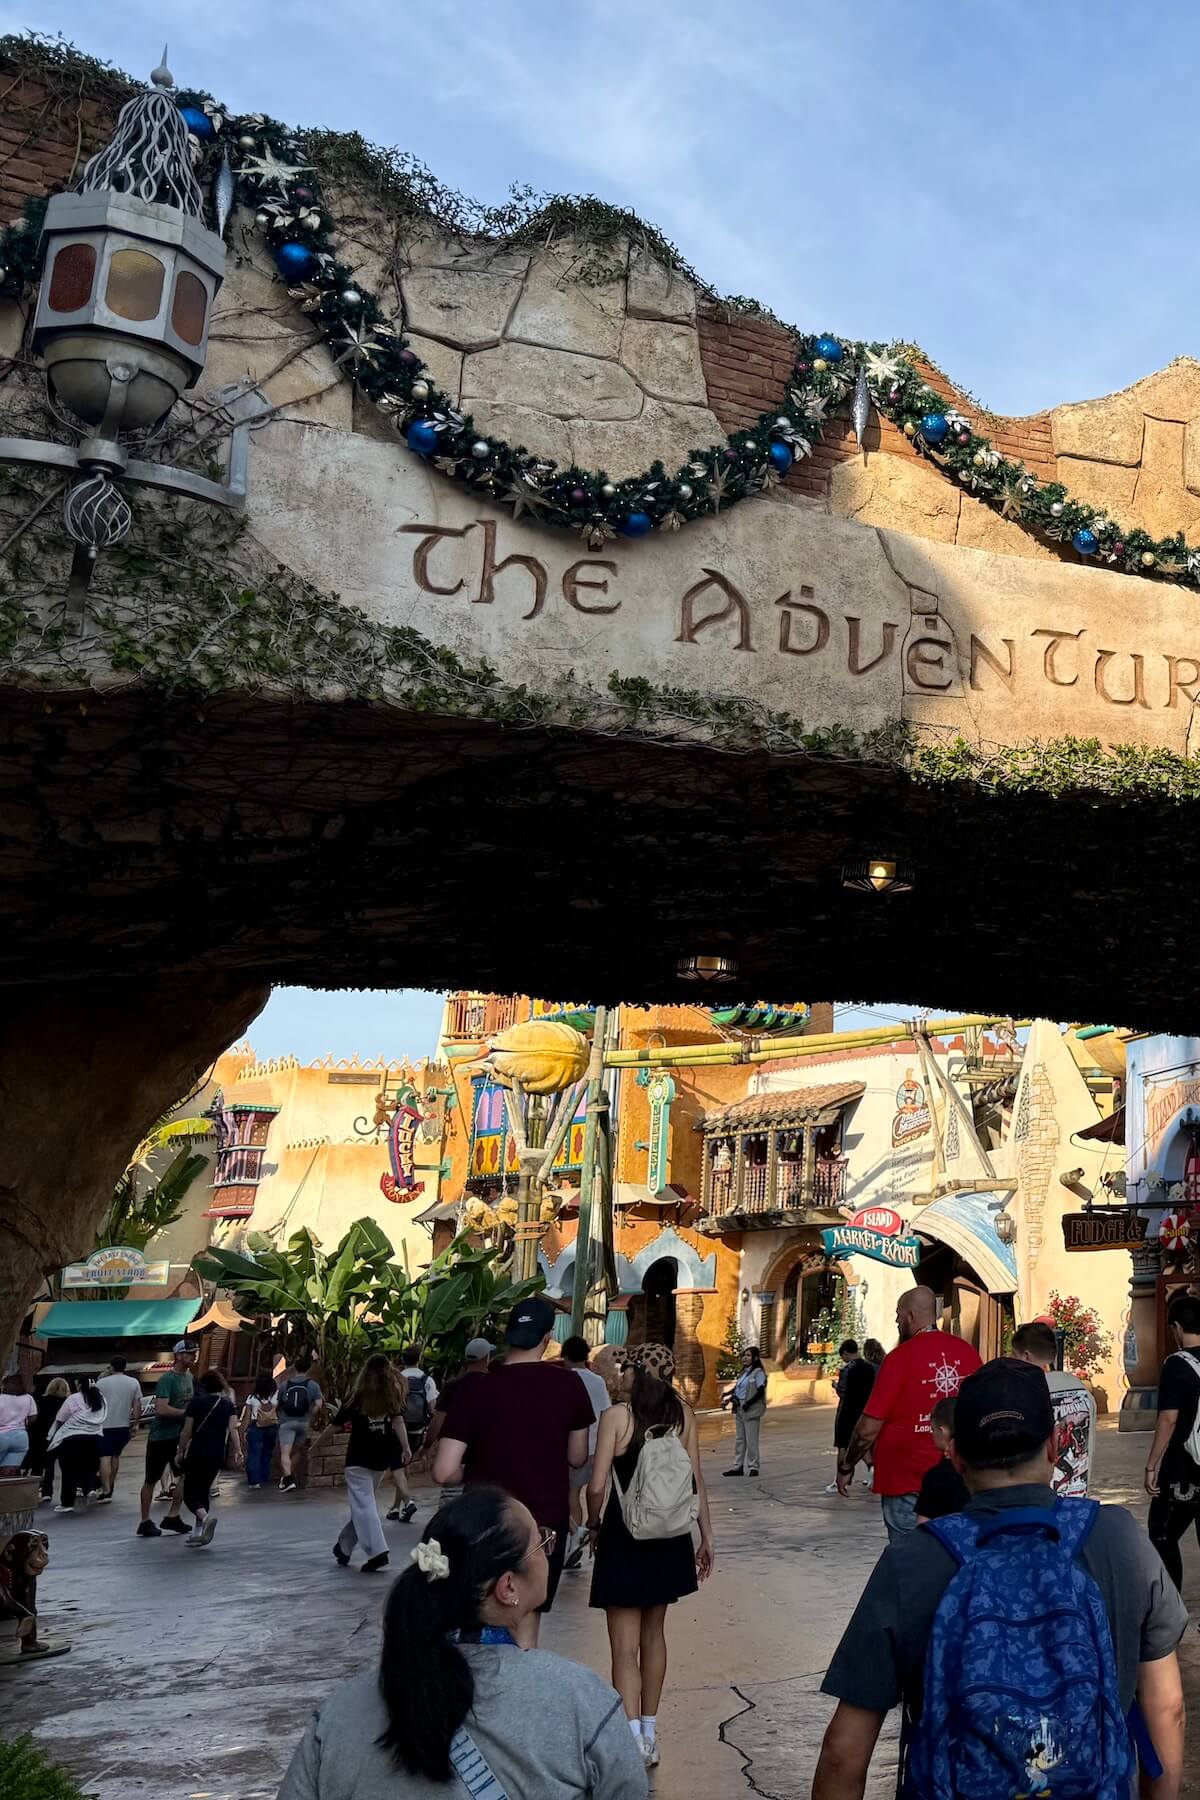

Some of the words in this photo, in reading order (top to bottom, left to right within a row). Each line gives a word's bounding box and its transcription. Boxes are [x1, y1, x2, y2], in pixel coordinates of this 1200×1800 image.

[398, 1112, 417, 1178] LUCKY
[863, 1211, 894, 1228] ISLAND
[1071, 1219, 1125, 1245] FUDGE
[1126, 1220, 1142, 1241] &
[832, 1228, 877, 1251] MARKET
[881, 1236, 918, 1266] EXPORT
